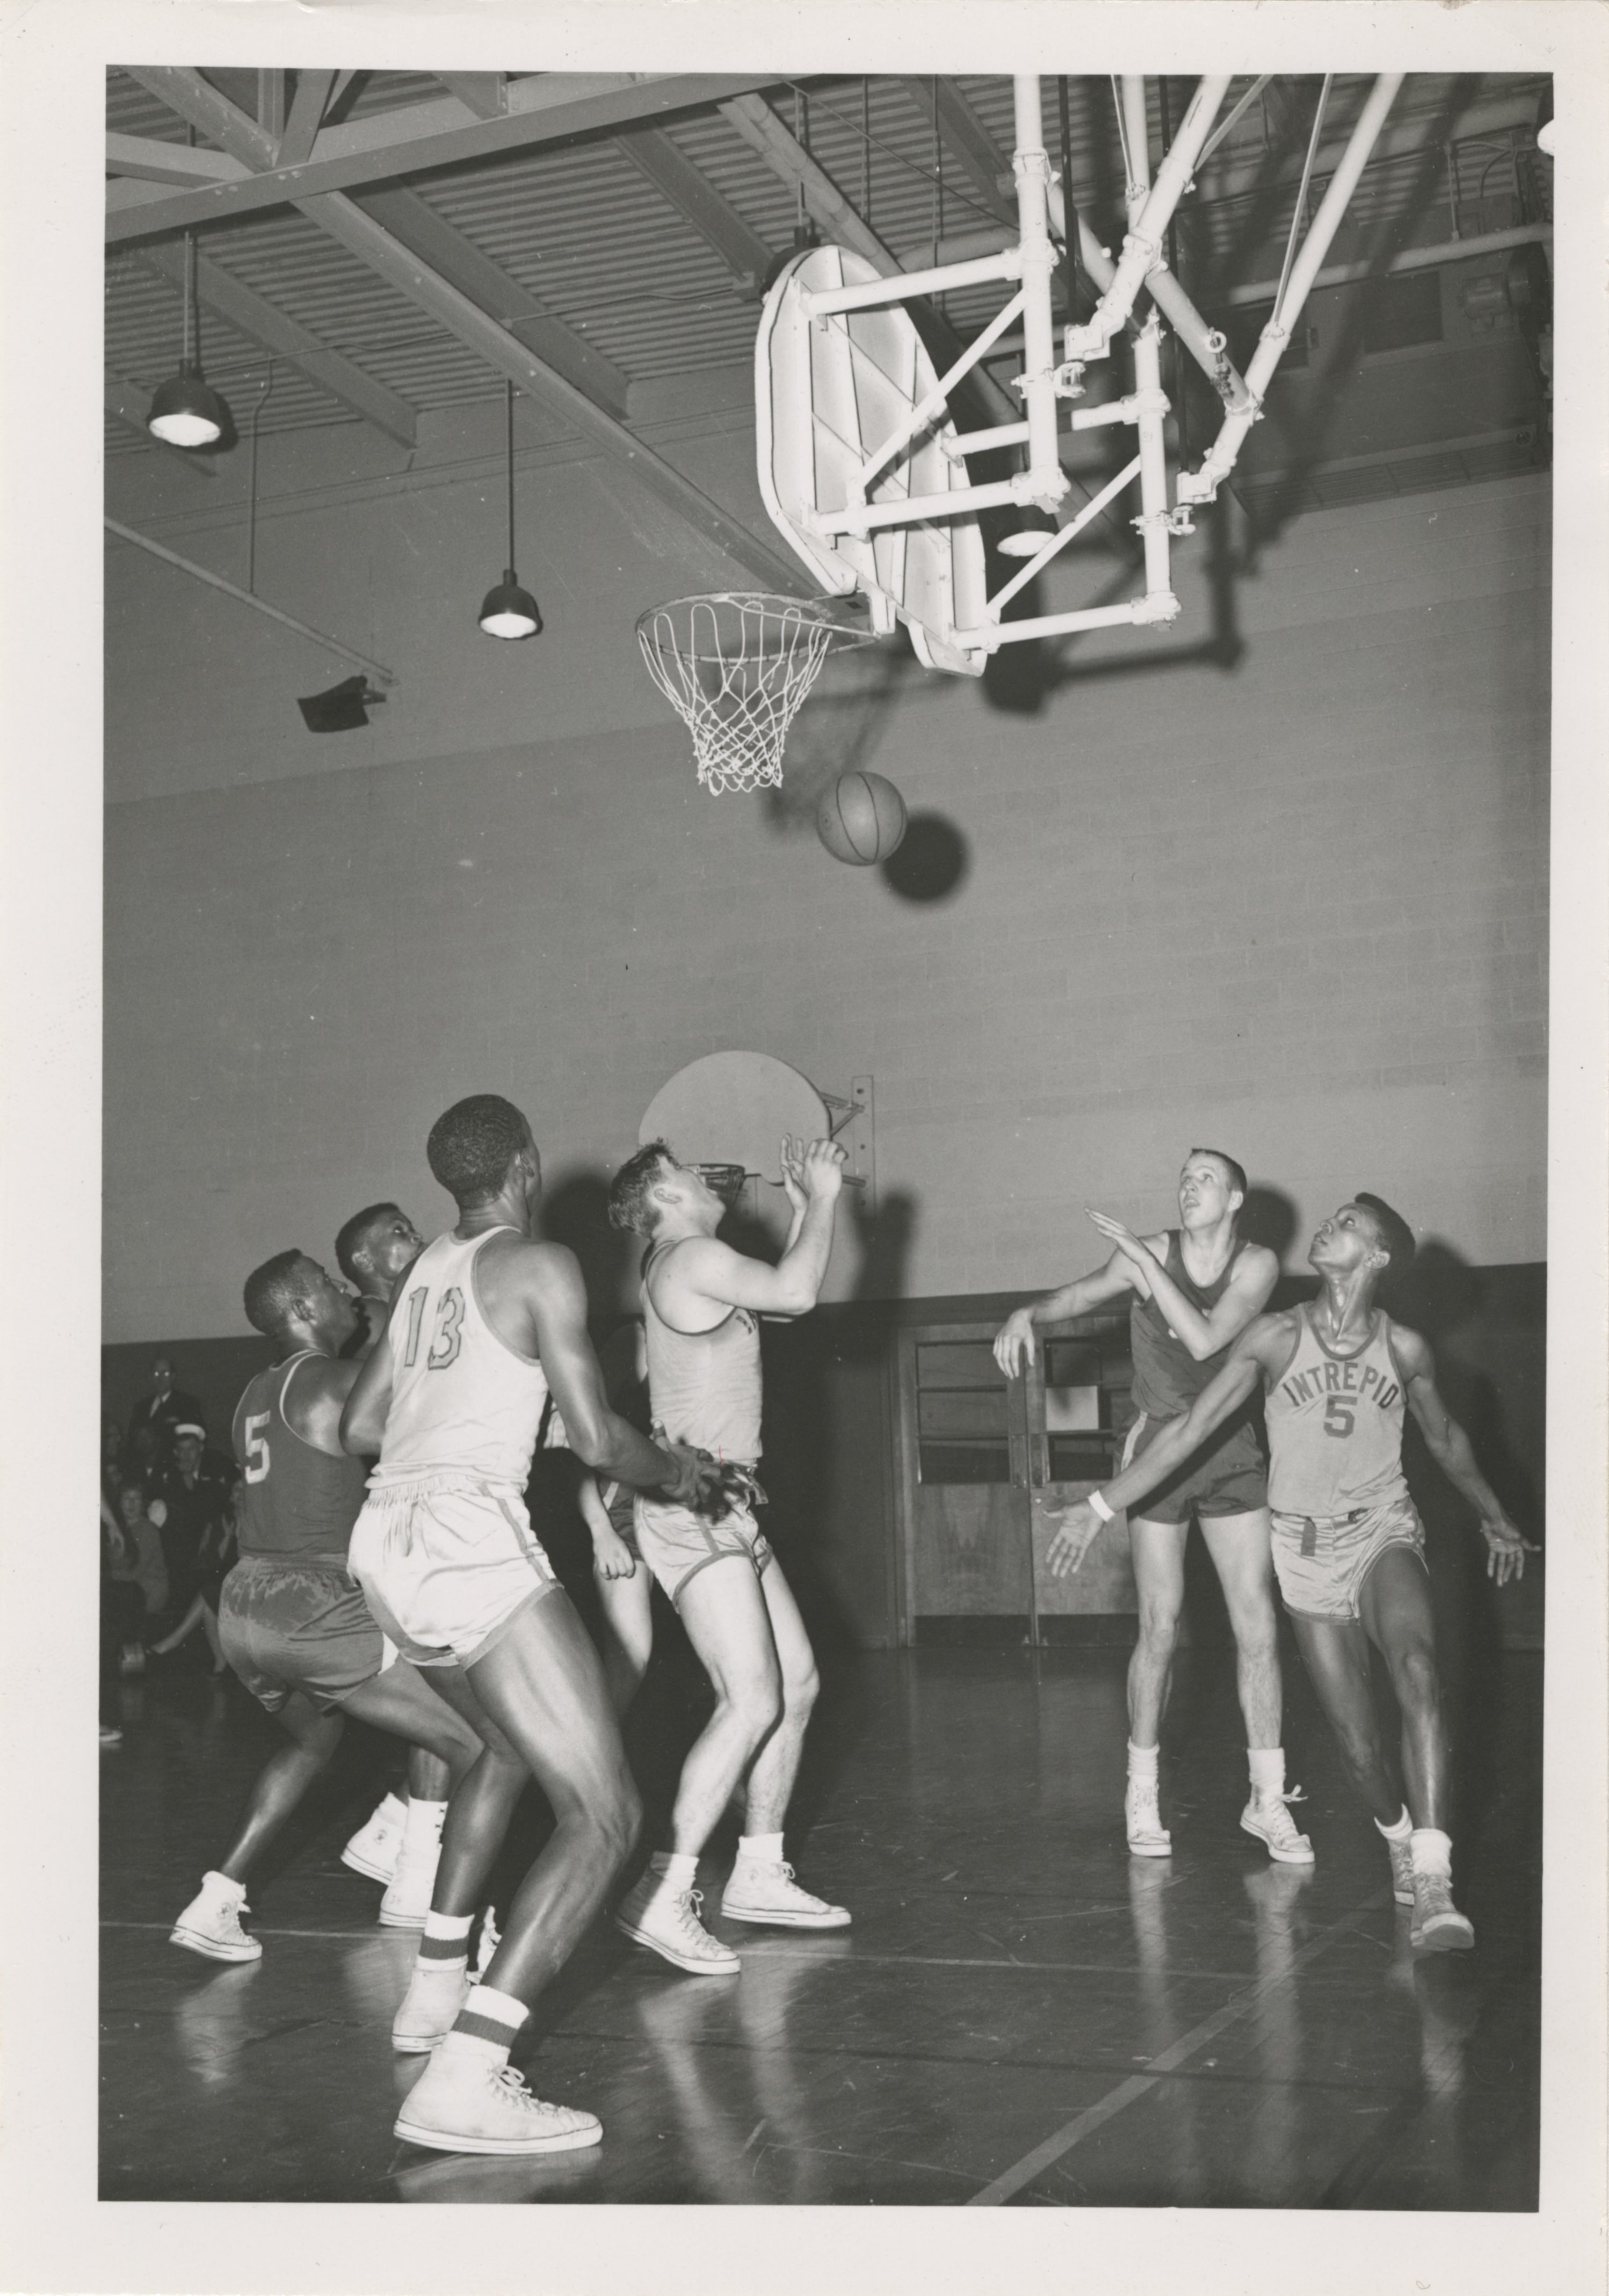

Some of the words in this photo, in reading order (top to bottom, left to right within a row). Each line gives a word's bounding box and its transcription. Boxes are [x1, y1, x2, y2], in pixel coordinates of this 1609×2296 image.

[404, 1287, 465, 1370] 13
[1282, 1362, 1399, 1408] INTREPID
[1323, 1394, 1358, 1438] 5
[245, 1410, 271, 1484] 5
